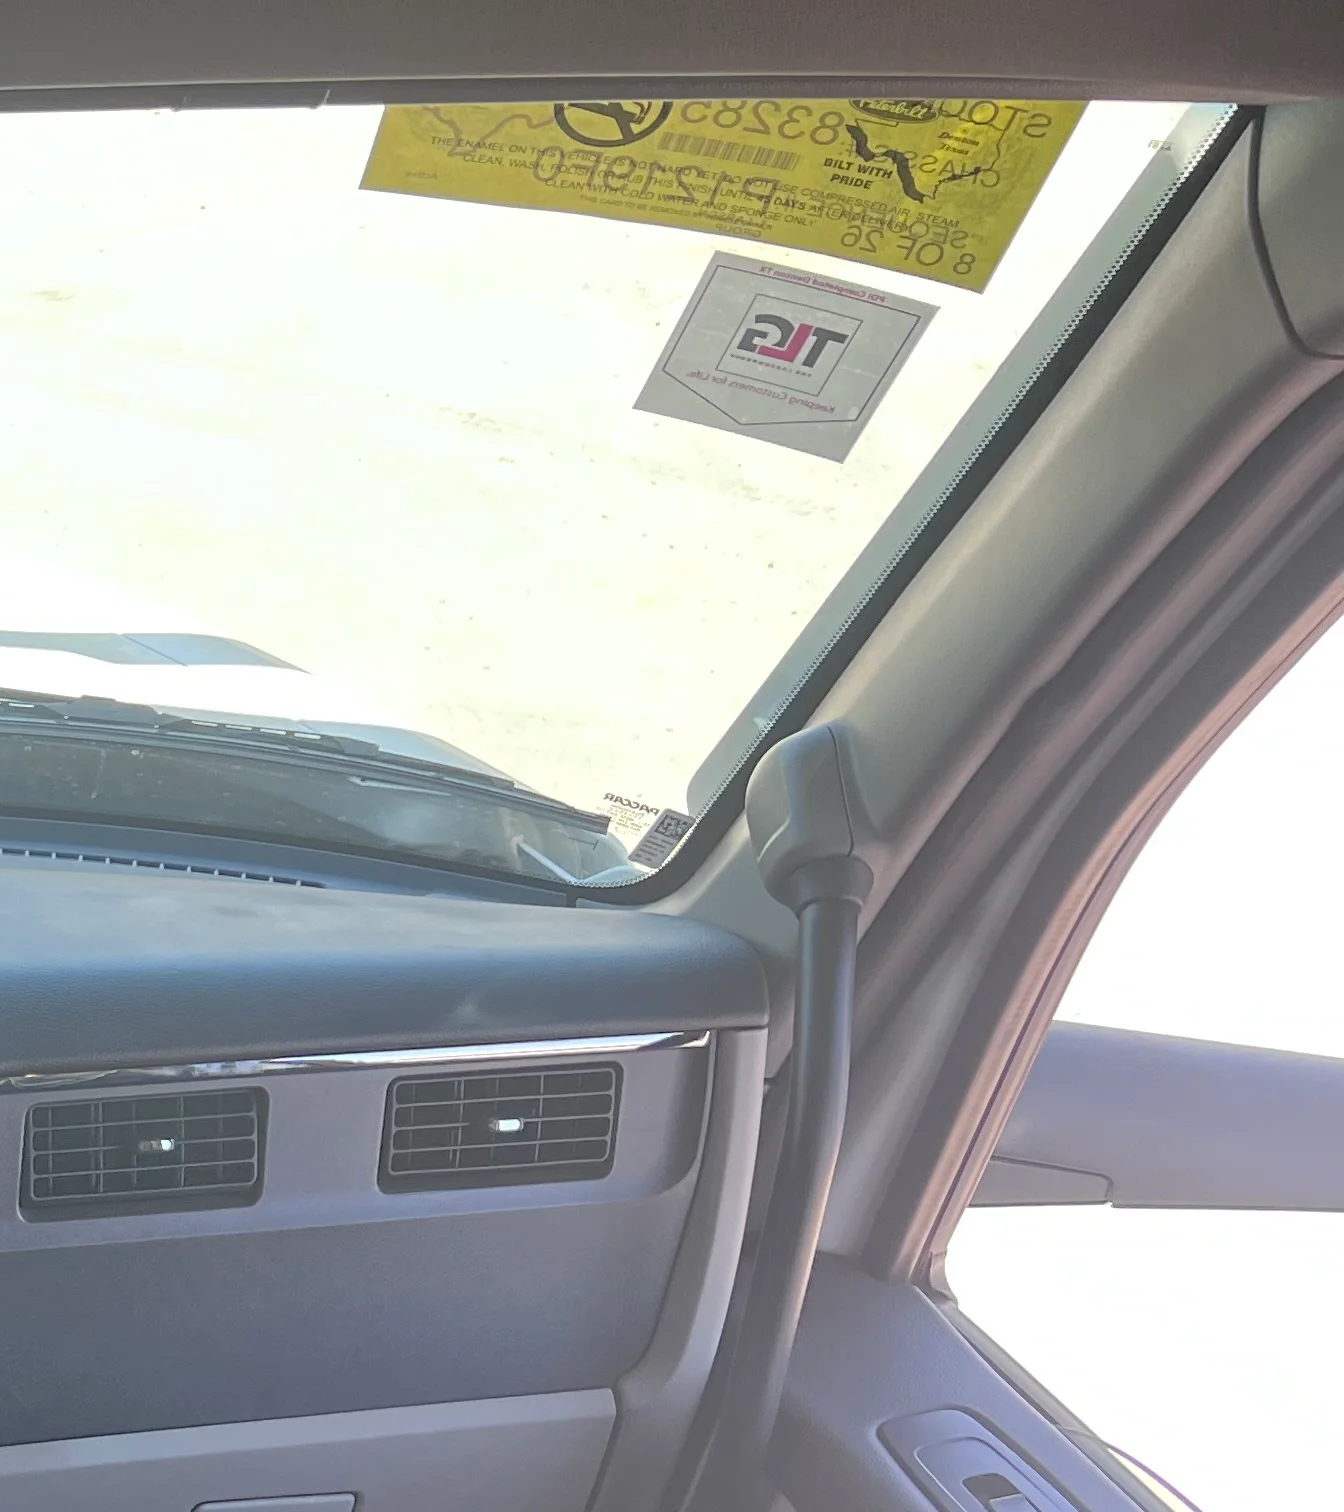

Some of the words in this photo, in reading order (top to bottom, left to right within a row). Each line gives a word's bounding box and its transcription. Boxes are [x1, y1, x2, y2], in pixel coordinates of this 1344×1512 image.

[431, 136, 453, 147] THE
[457, 139, 505, 152] ENAMEL
[509, 144, 528, 154] ON
[530, 147, 557, 159] THIS
[776, 181, 800, 194] USE
[916, 212, 960, 229] STEAM
[823, 156, 855, 172] BILT
[857, 163, 894, 180] WITH
[830, 173, 874, 190] PRIDE
[545, 179, 585, 192] CLEAN
[621, 187, 654, 201] COLD
[702, 200, 728, 213] AND
[730, 204, 781, 222] SPONGE
[784, 213, 816, 228] ONLY
